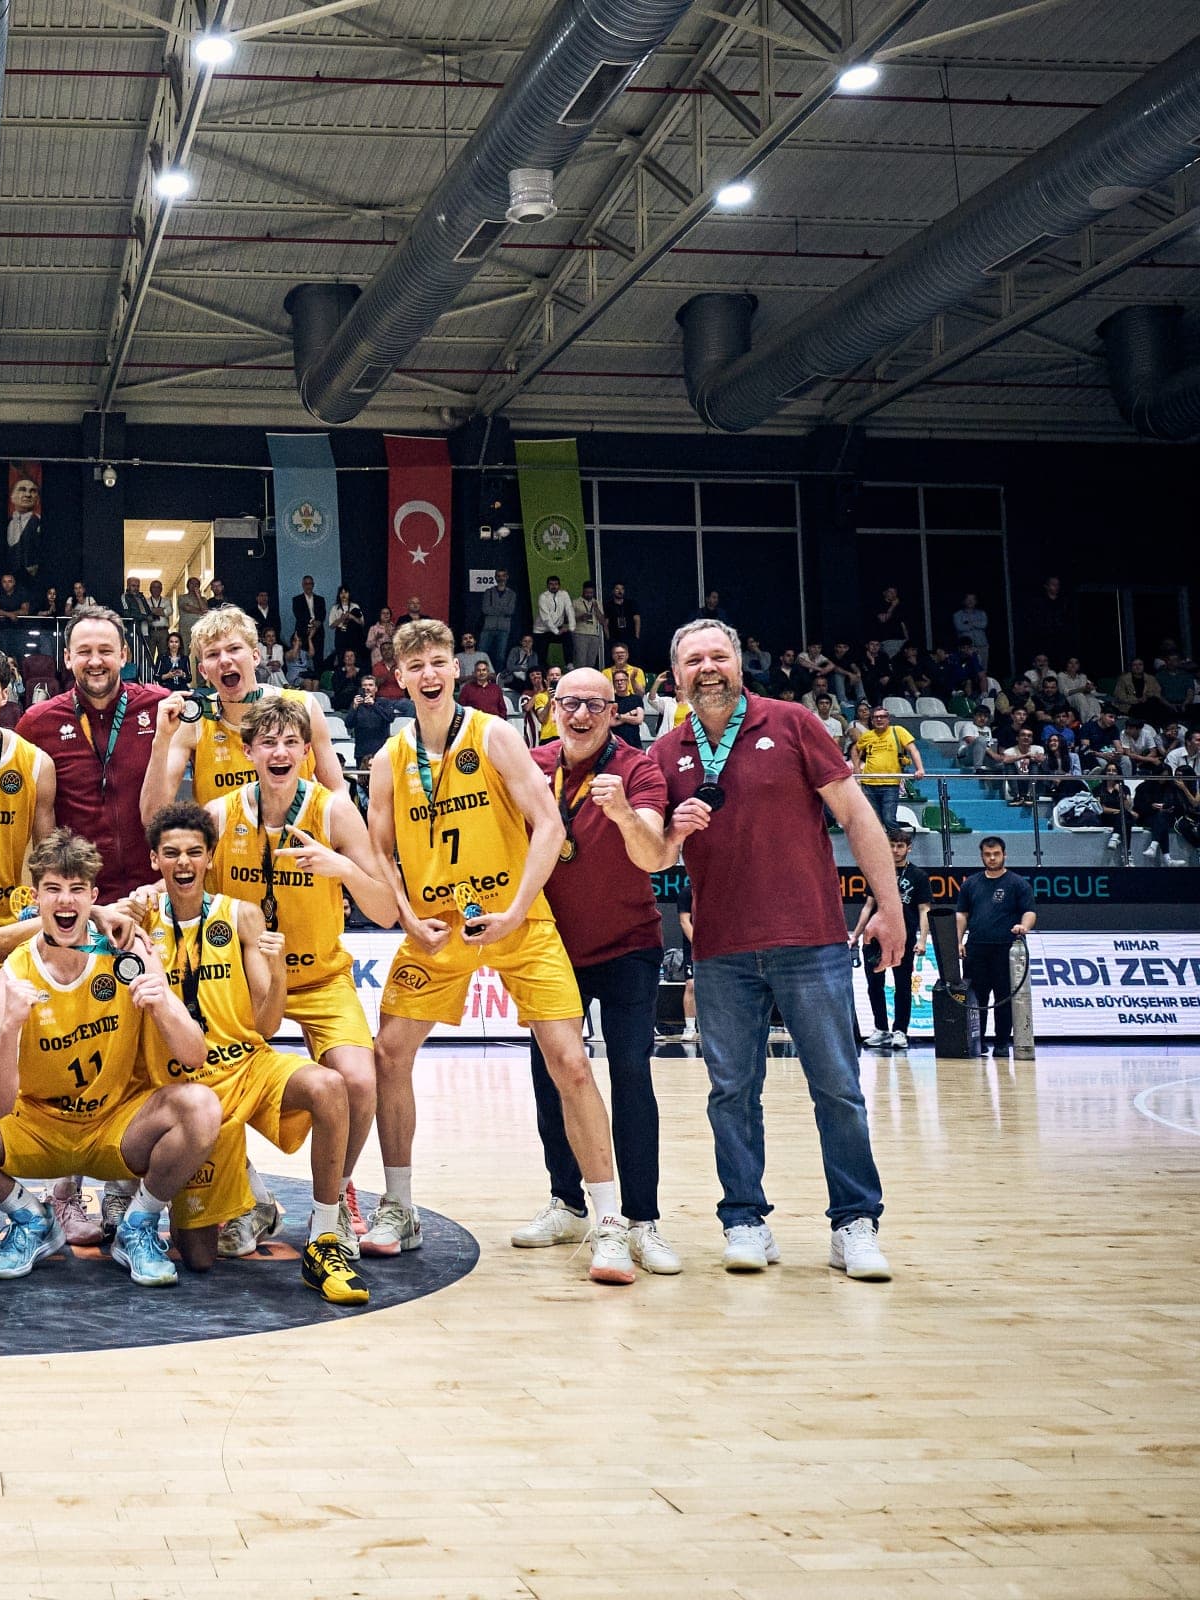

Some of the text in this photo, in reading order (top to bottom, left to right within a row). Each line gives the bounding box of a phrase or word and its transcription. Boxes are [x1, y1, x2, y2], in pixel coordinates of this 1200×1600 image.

[476, 576, 495, 585] 202
[214, 769, 259, 788] OOST
[409, 791, 490, 822] OOSTENDE
[441, 827, 460, 865] 7
[421, 871, 510, 902] Cortec
[398, 970, 428, 991] P&V
[39, 1014, 119, 1052] OOSTENDE
[67, 1050, 104, 1089] 11
